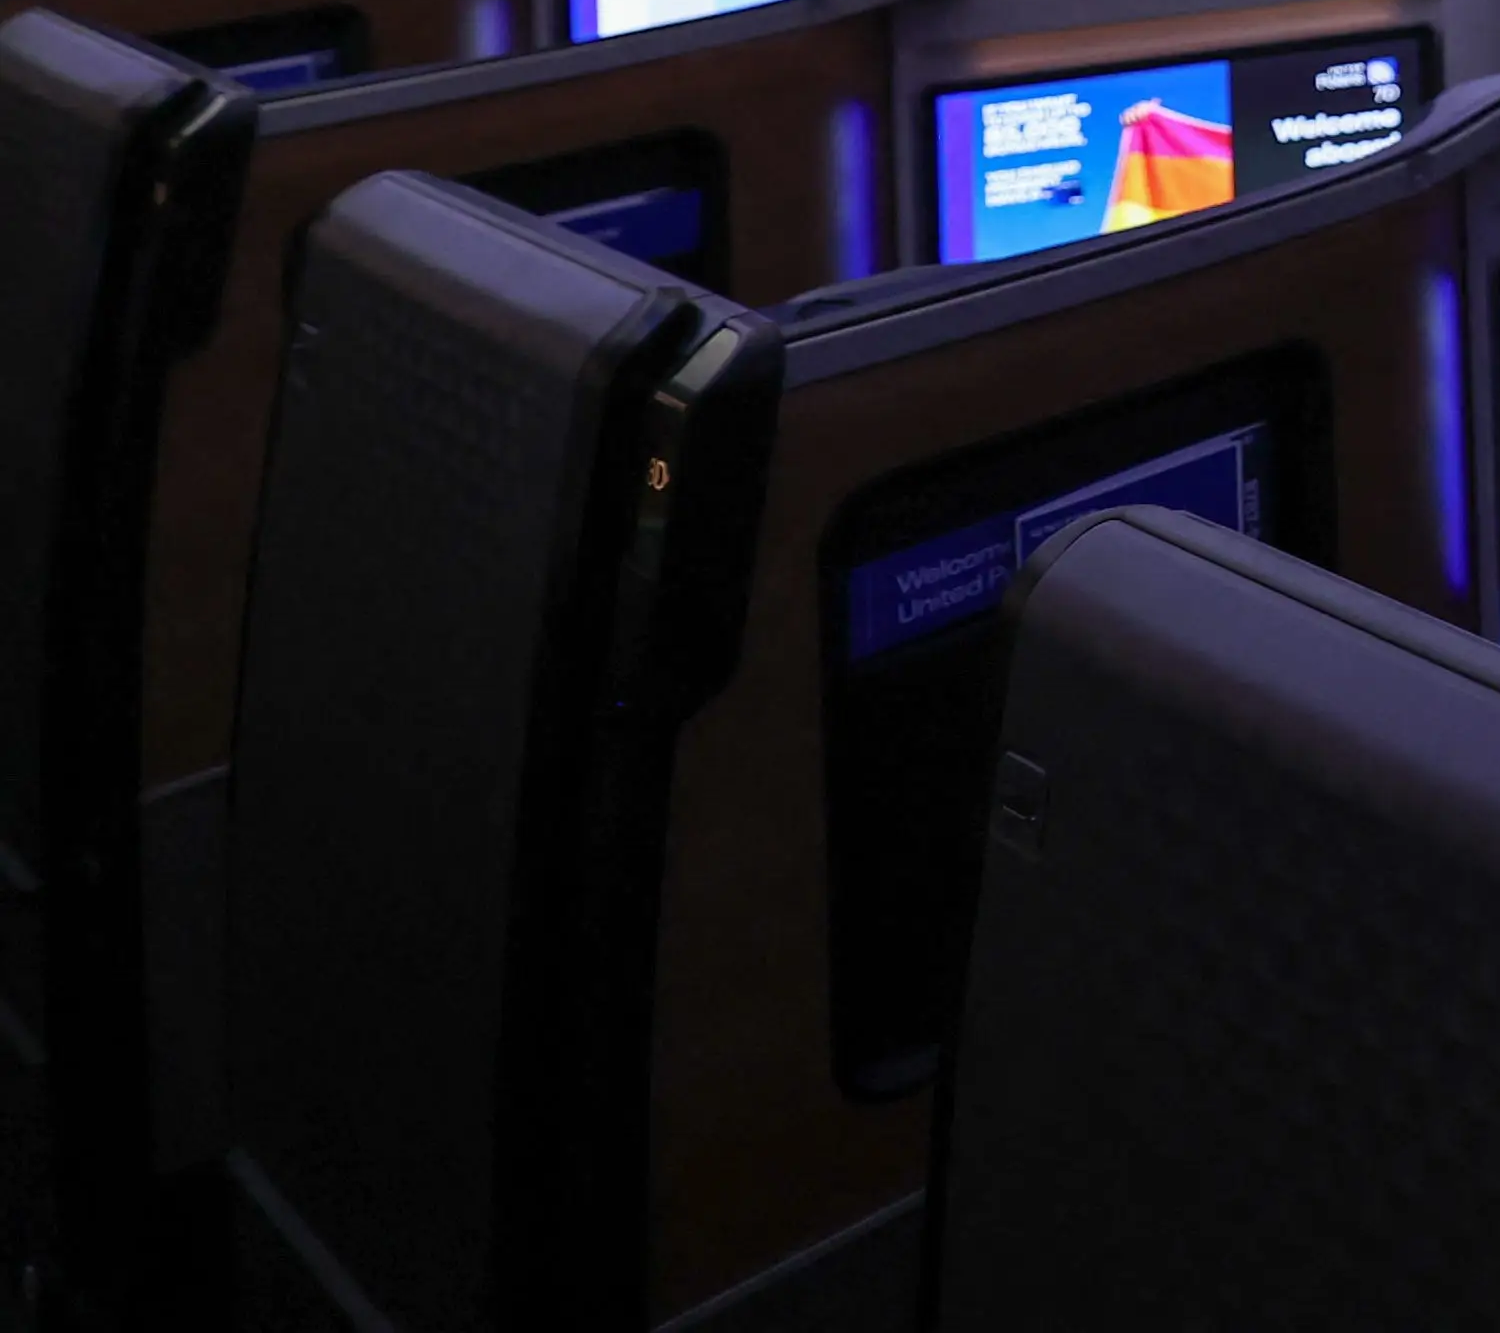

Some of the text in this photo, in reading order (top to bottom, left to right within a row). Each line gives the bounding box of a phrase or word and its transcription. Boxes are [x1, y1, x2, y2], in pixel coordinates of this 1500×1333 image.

[1271, 108, 1401, 144] Welcome
[1305, 131, 1402, 168] aboa
[898, 576, 984, 625] United
